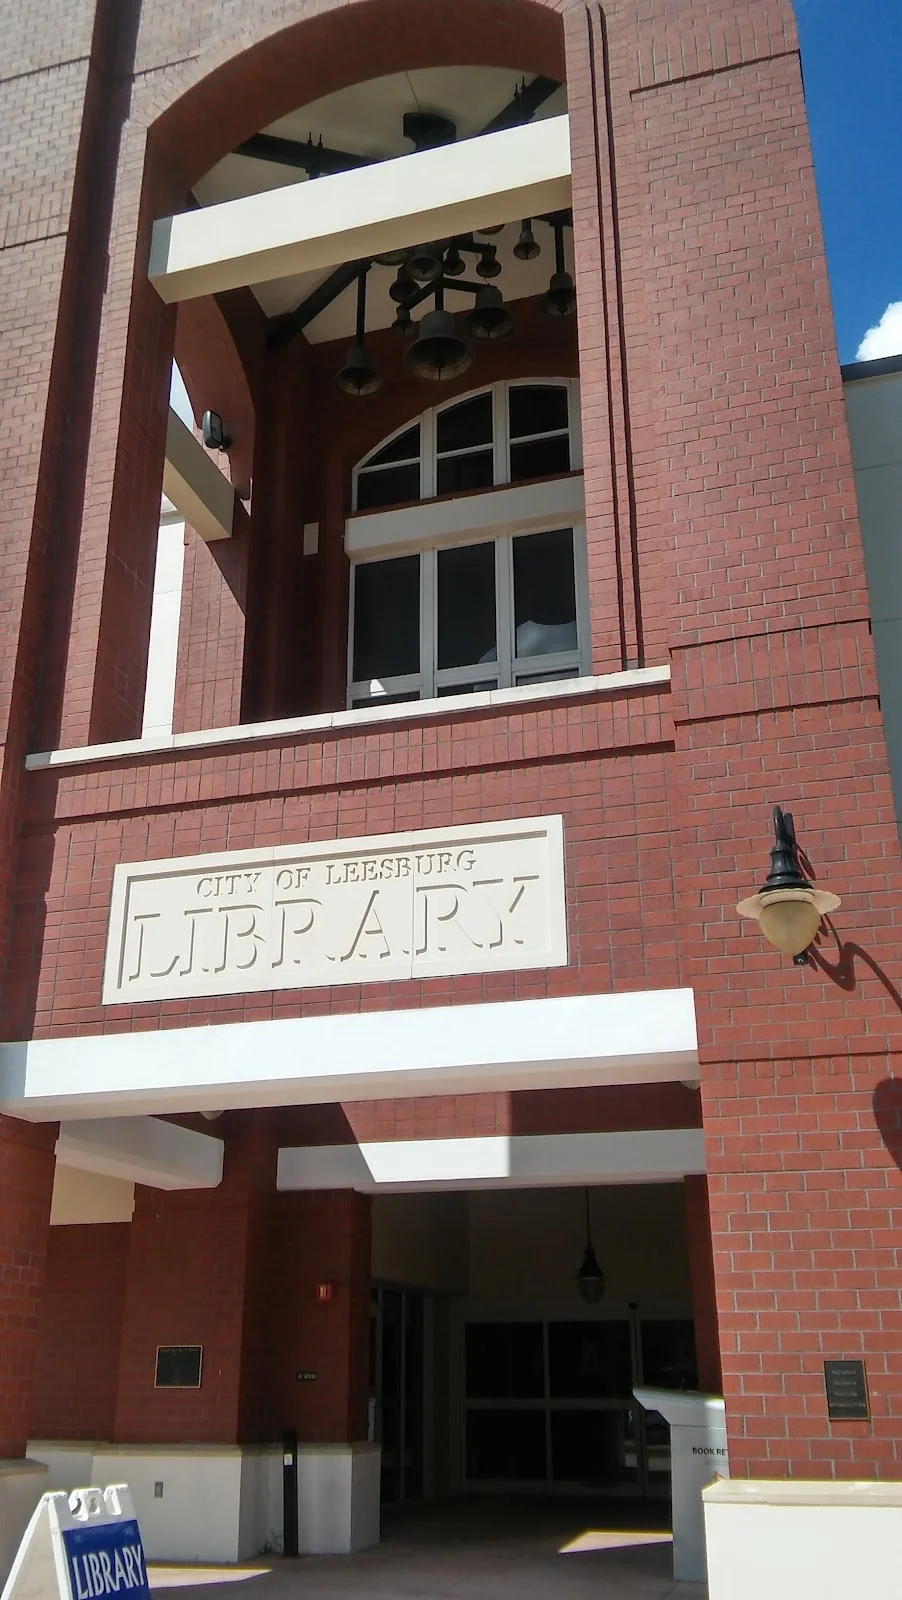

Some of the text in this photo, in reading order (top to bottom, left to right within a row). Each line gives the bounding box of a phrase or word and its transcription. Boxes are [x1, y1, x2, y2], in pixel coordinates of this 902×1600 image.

[196, 849, 477, 898] CITY OF LEESBURG
[128, 874, 540, 982] LIBRARY
[692, 1446, 715, 1456] BOOK
[72, 1544, 145, 1600] LIBRARY
